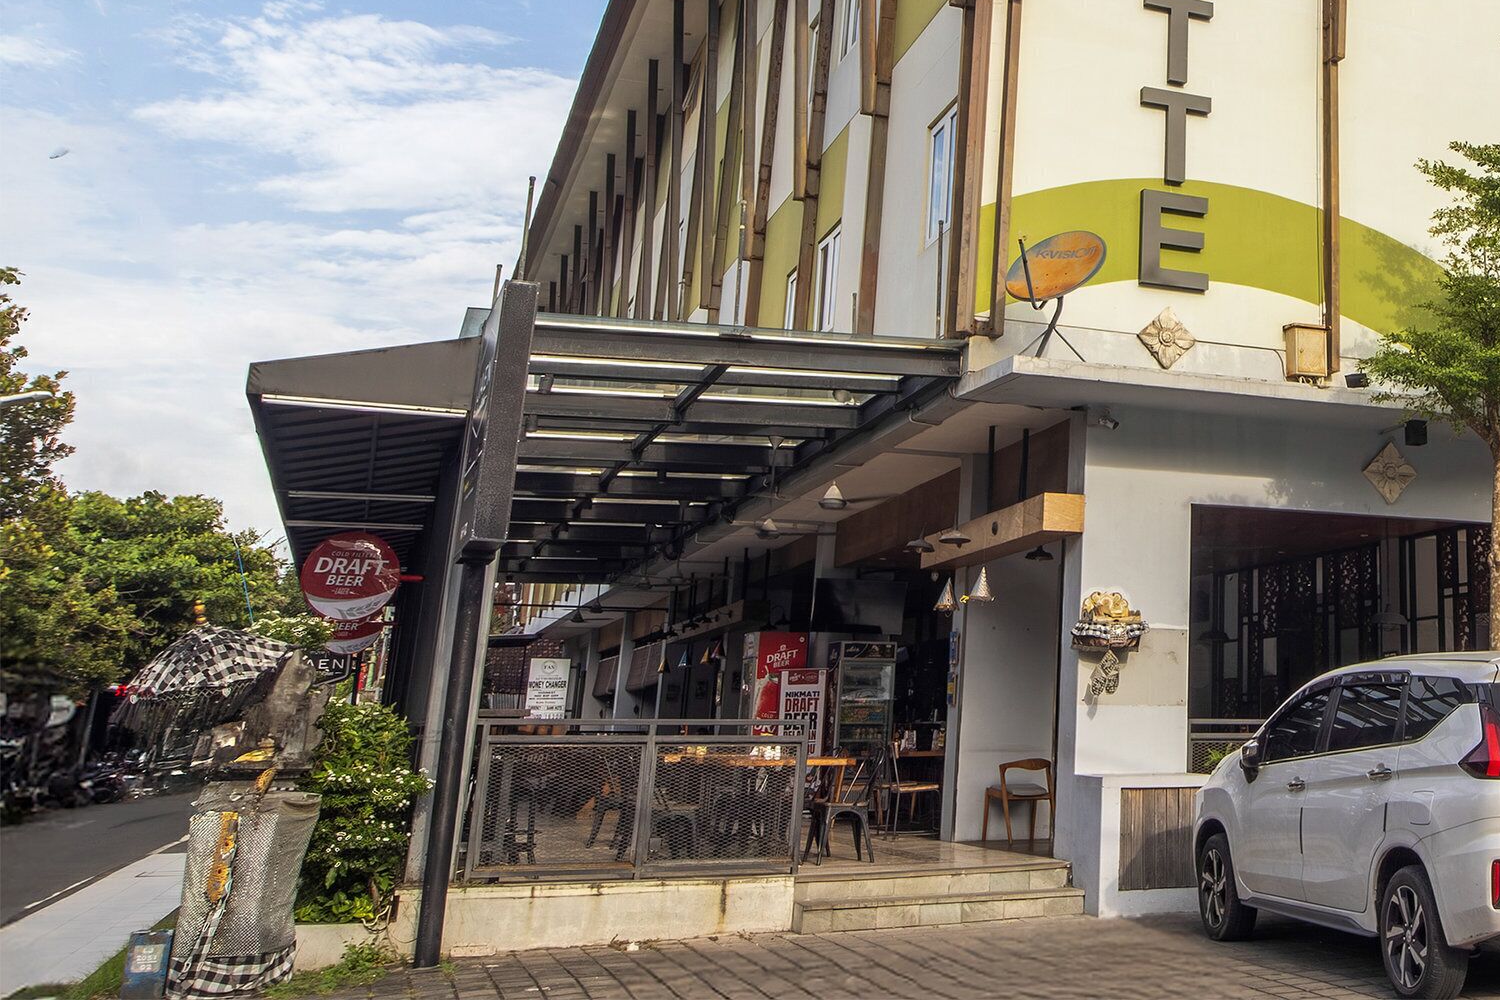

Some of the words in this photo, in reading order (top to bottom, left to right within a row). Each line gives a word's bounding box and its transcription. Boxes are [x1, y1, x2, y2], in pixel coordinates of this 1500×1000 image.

[314, 557, 389, 575] DRAFT
[326, 574, 364, 586] BEER
[766, 649, 798, 663] DRAFT
[773, 660, 789, 668] BEER
[785, 698, 819, 712] DRAFT
